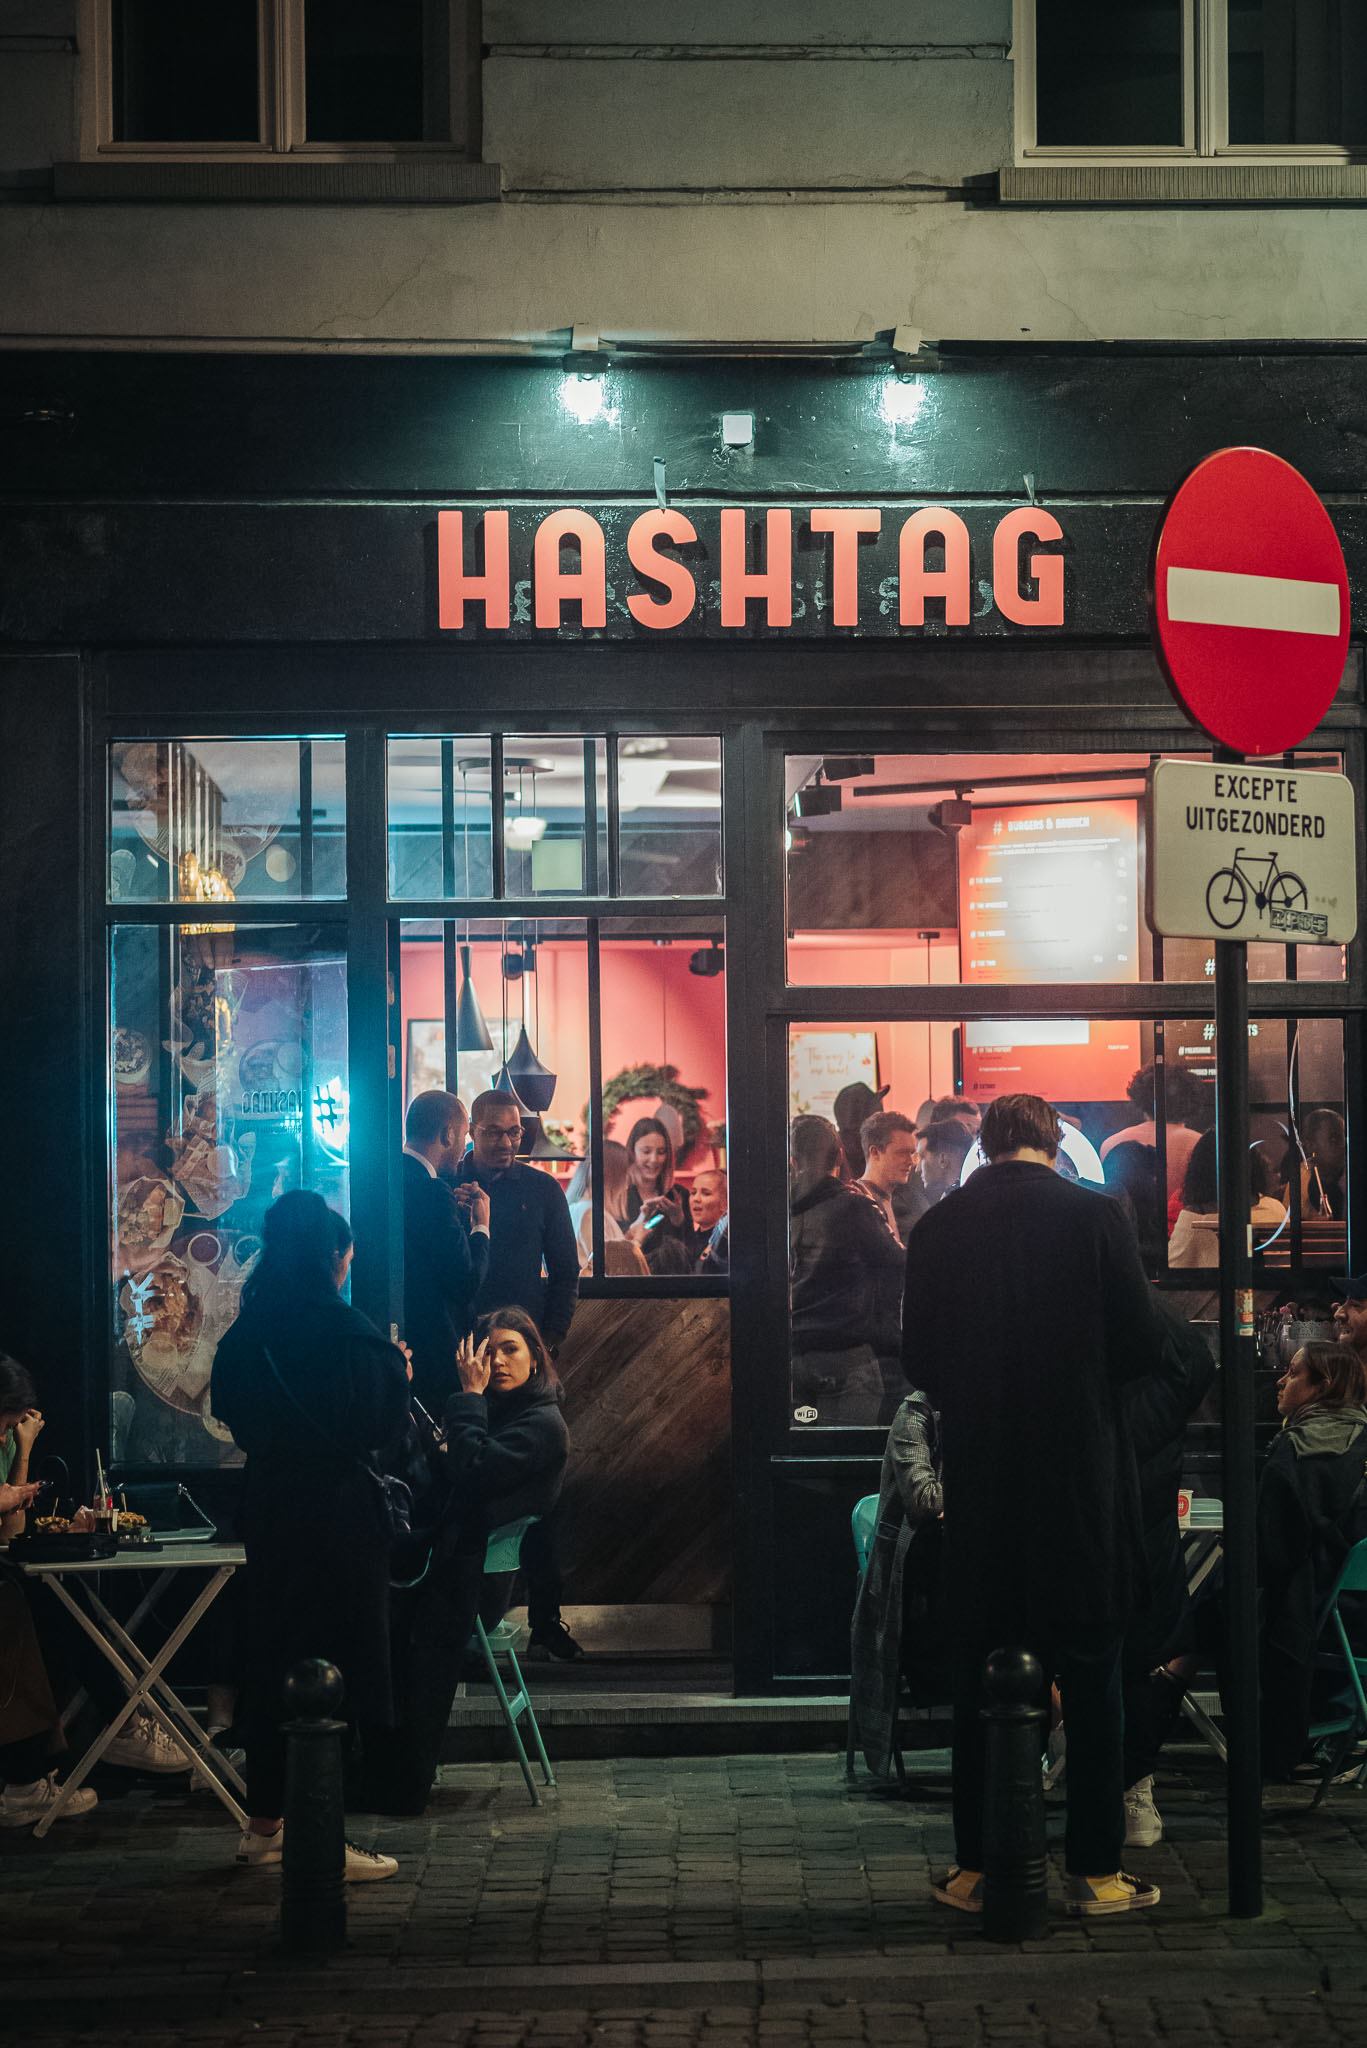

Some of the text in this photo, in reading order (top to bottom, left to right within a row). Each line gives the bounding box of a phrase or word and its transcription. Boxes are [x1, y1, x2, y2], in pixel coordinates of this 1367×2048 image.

[438, 506, 1064, 629] HASHTAG
[1214, 774, 1298, 803] EXCEPTE
[1186, 806, 1325, 839] UITGEZONDERD
